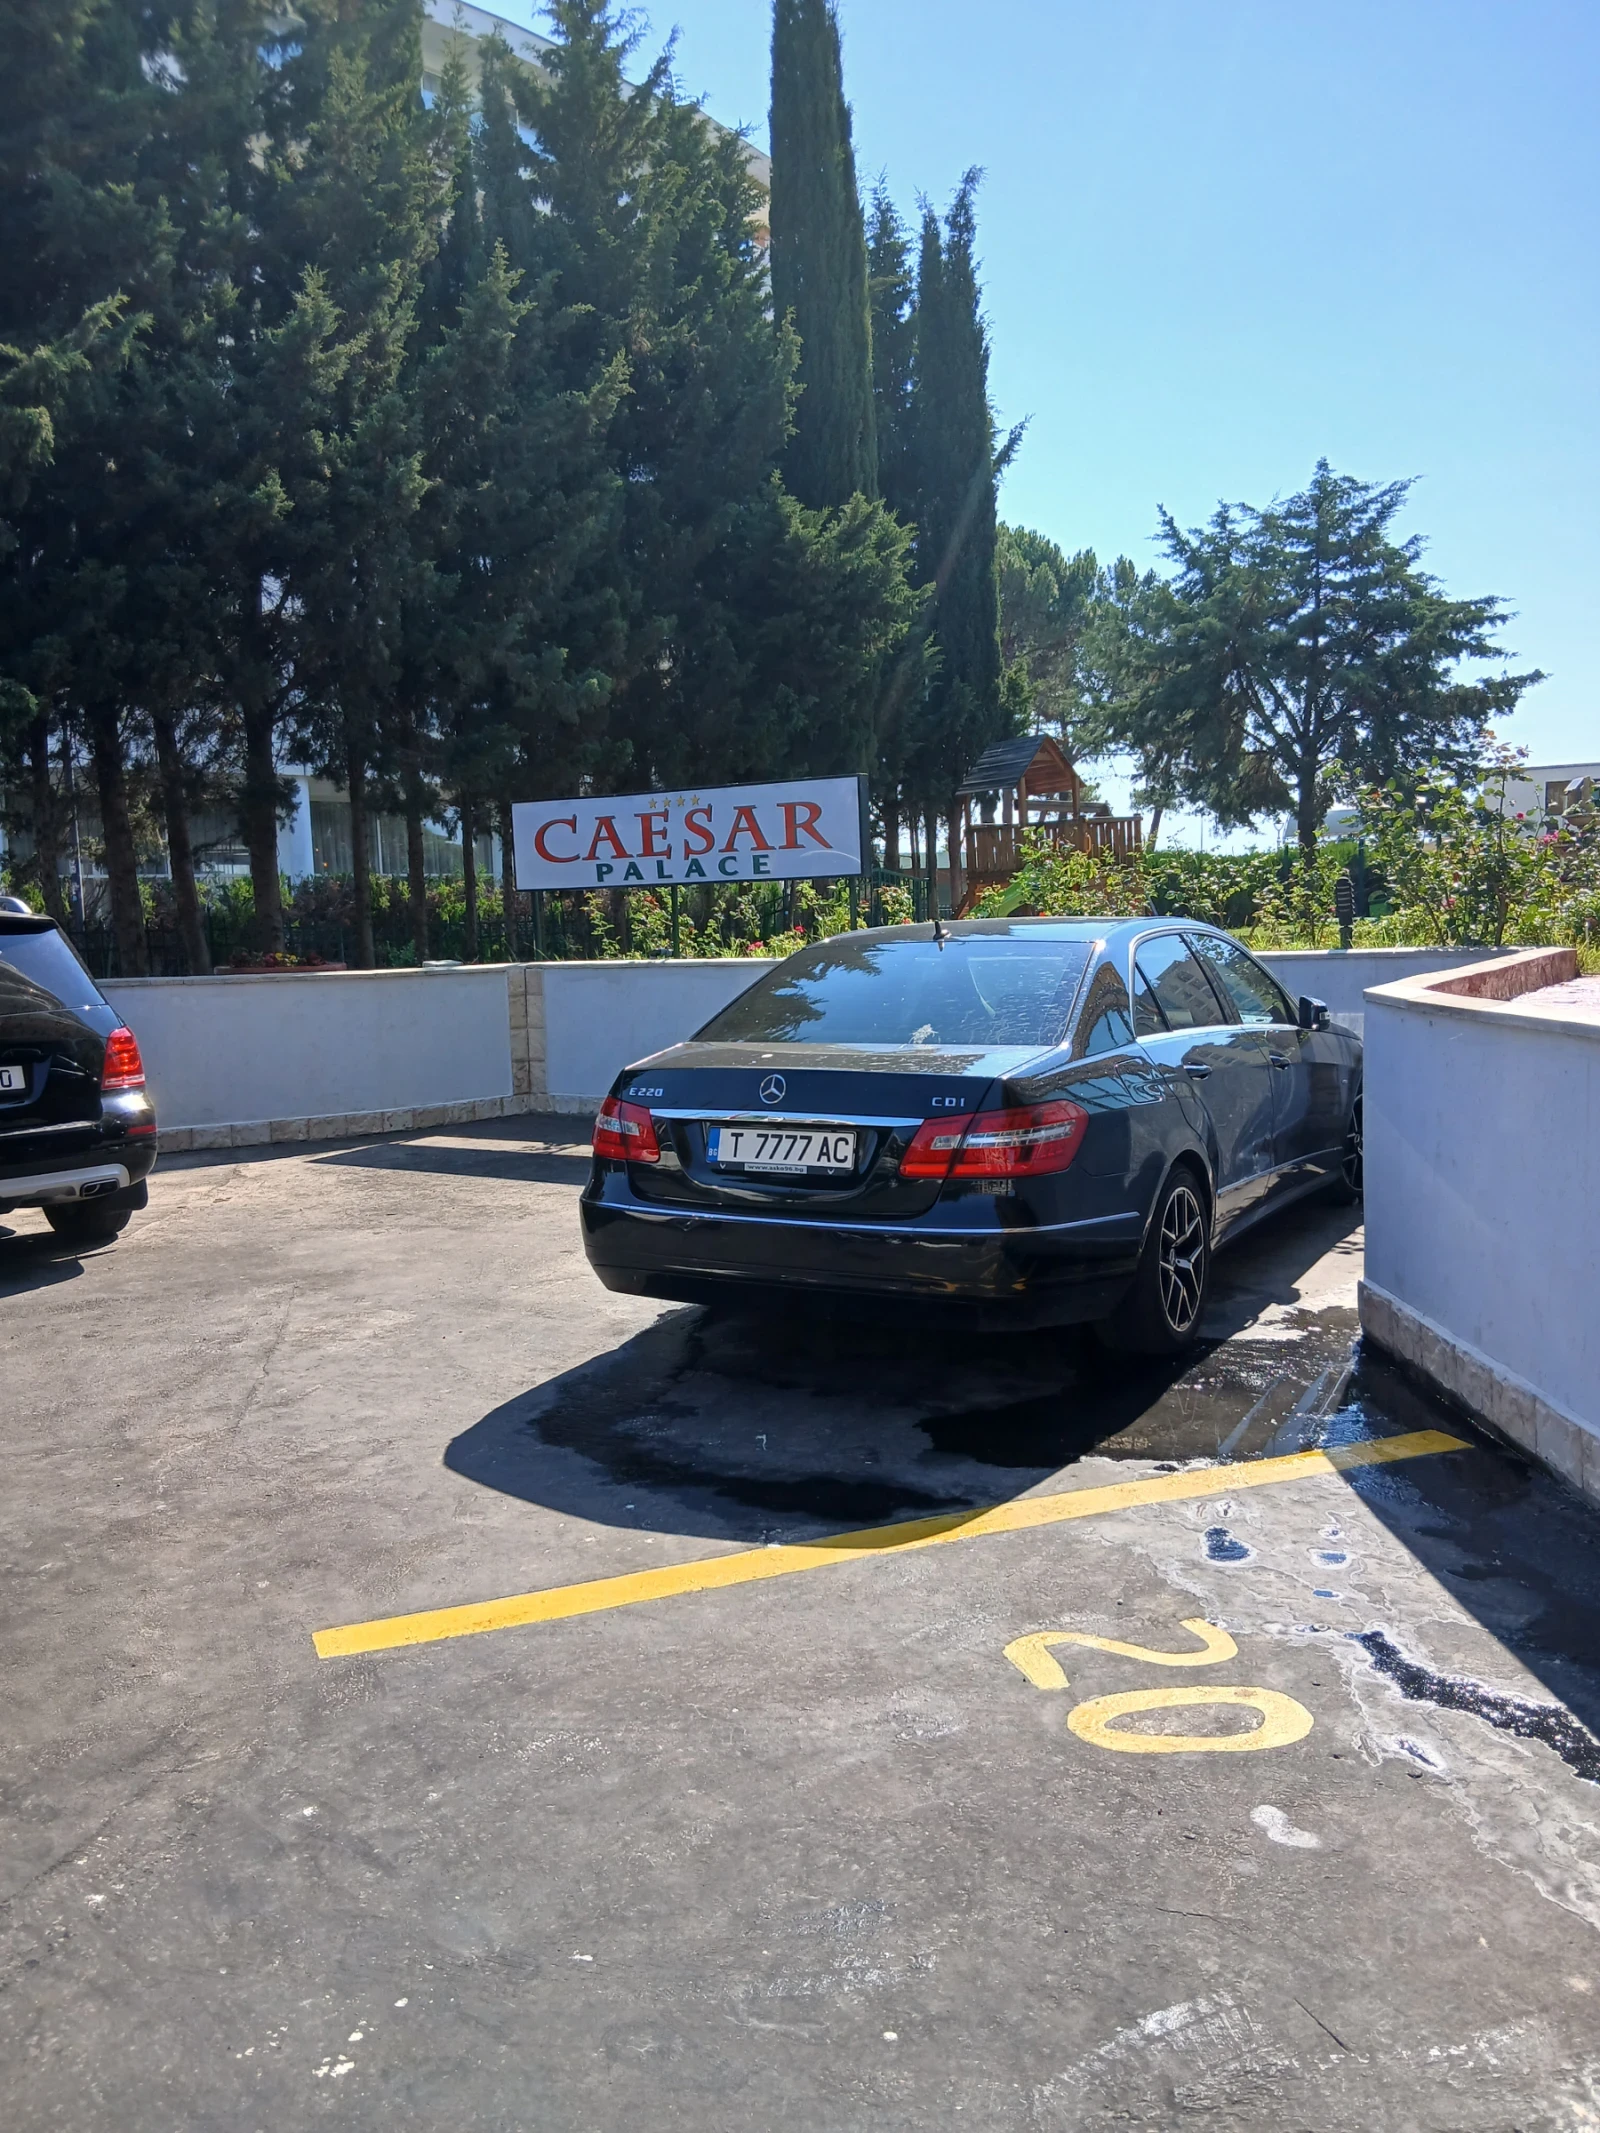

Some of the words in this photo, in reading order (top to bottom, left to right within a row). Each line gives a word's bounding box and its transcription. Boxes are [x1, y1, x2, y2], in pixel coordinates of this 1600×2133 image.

[534, 801, 833, 864] CAESAR
[596, 854, 772, 882] PALACE
[931, 1096, 965, 1107] CDI
[708, 1147, 718, 1156] BG
[730, 1132, 744, 1158] T
[755, 1133, 813, 1162] 7777
[817, 1136, 849, 1164] AC
[1002, 1617, 1314, 1753] 20
